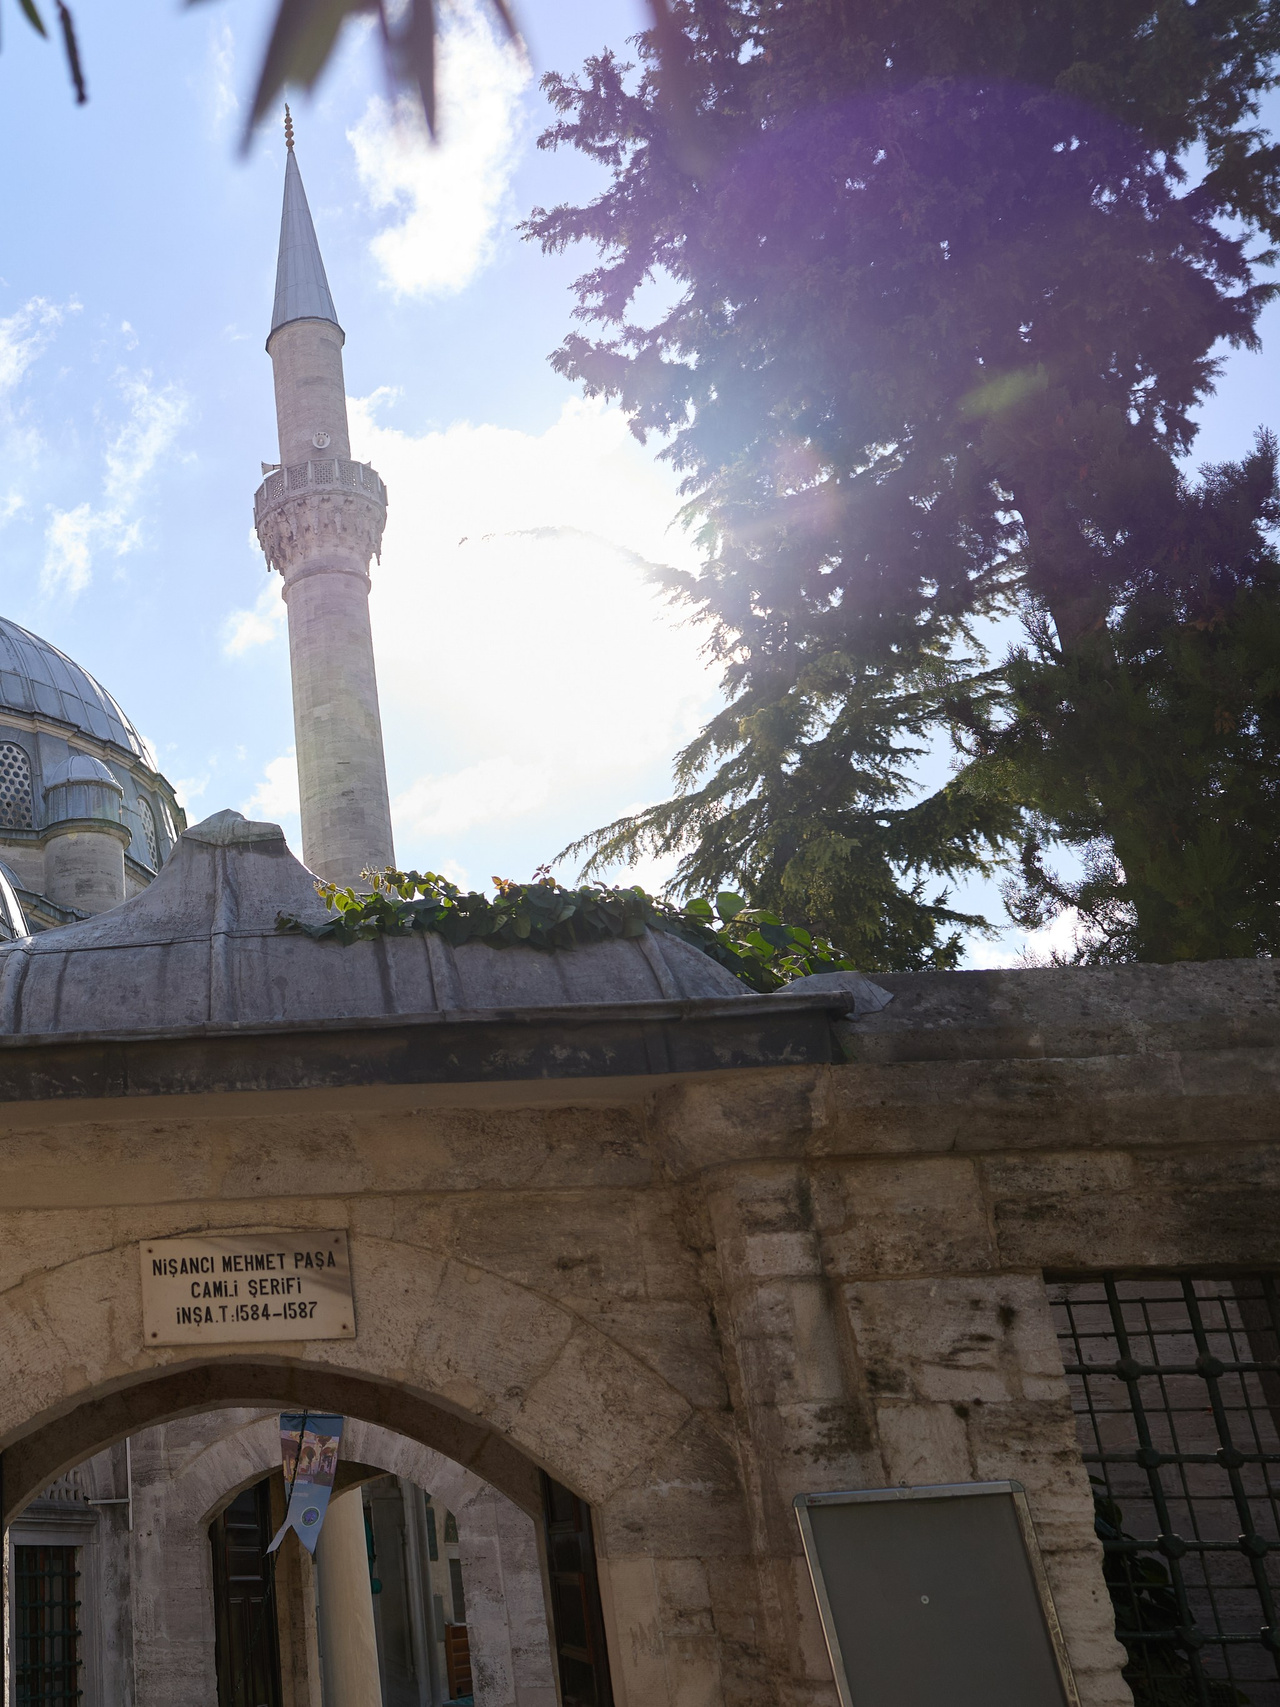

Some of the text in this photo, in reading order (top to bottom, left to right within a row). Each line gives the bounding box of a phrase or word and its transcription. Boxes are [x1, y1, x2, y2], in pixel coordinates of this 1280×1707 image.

[152, 1250, 336, 1278] NİŞANCI MEHMET PAŞA
[247, 1277, 302, 1298] ŞERİFİ
